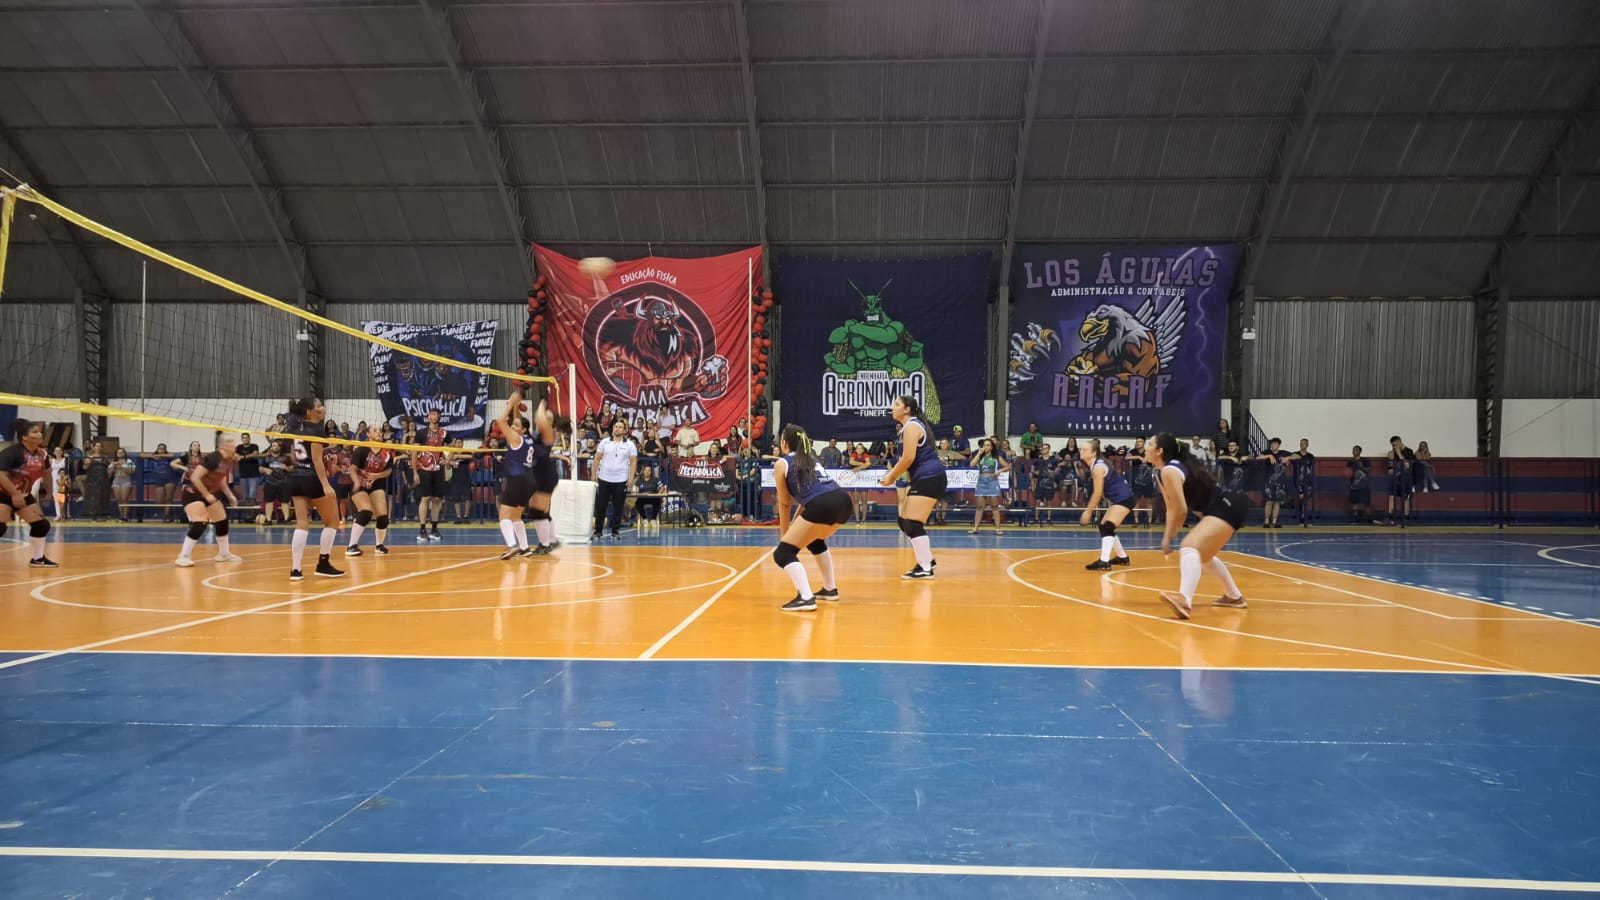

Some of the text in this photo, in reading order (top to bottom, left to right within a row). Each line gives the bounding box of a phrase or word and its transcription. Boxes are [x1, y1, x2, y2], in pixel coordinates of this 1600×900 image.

[620, 267, 655, 284] EDUCAÇÃO
[1024, 252, 1218, 288] LOS ÁGUIAS
[1051, 286, 1124, 296] ADMINISTRAÇÃO
[1136, 287, 1186, 296] CONTÁBEIS
[860, 409, 887, 417] FUNEPE
[293, 438, 308, 460] 5
[526, 446, 535, 463] 8
